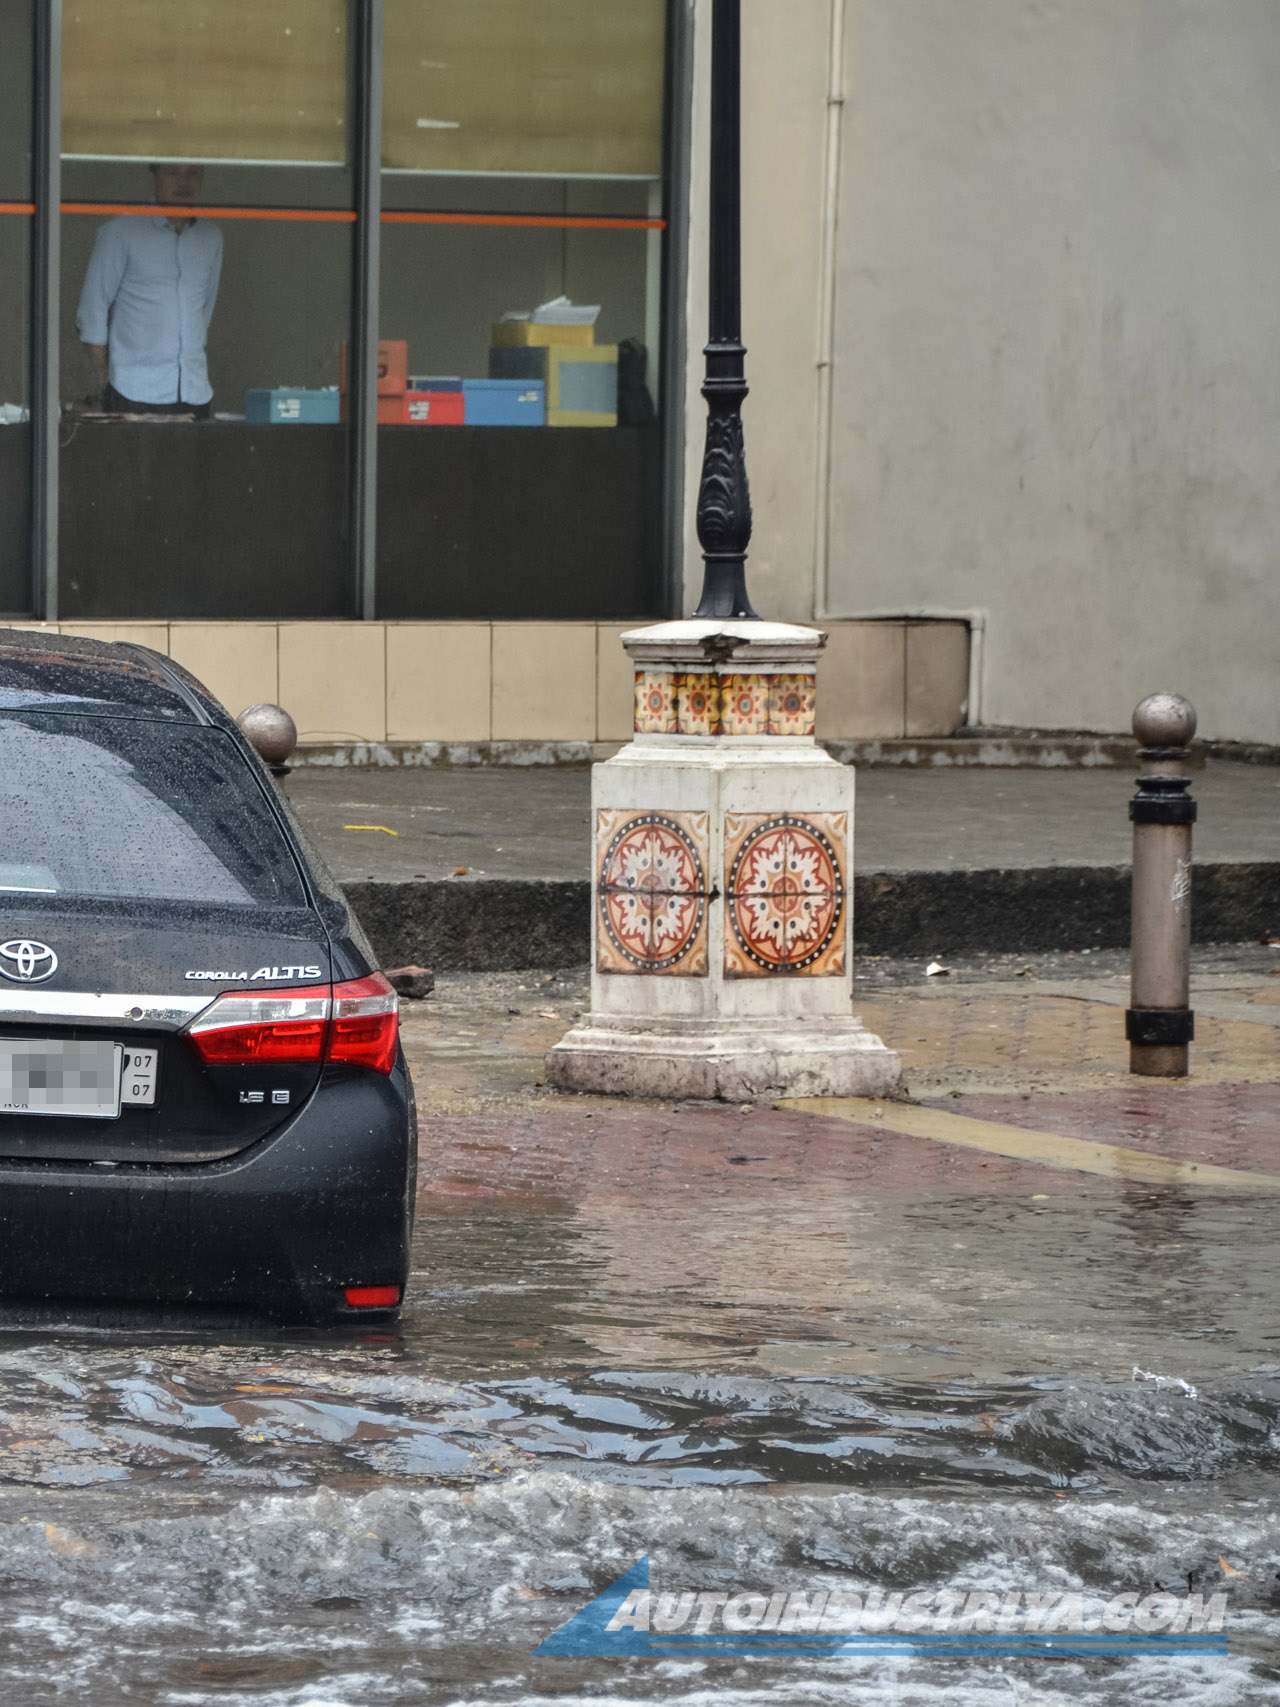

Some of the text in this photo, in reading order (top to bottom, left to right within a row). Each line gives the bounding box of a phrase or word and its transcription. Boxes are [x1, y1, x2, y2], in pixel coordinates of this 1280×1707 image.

[184, 965, 322, 981] COROLLA ALTIS
[133, 1055, 153, 1068] 07
[131, 1084, 151, 1096] 07
[271, 1090, 290, 1104] E
